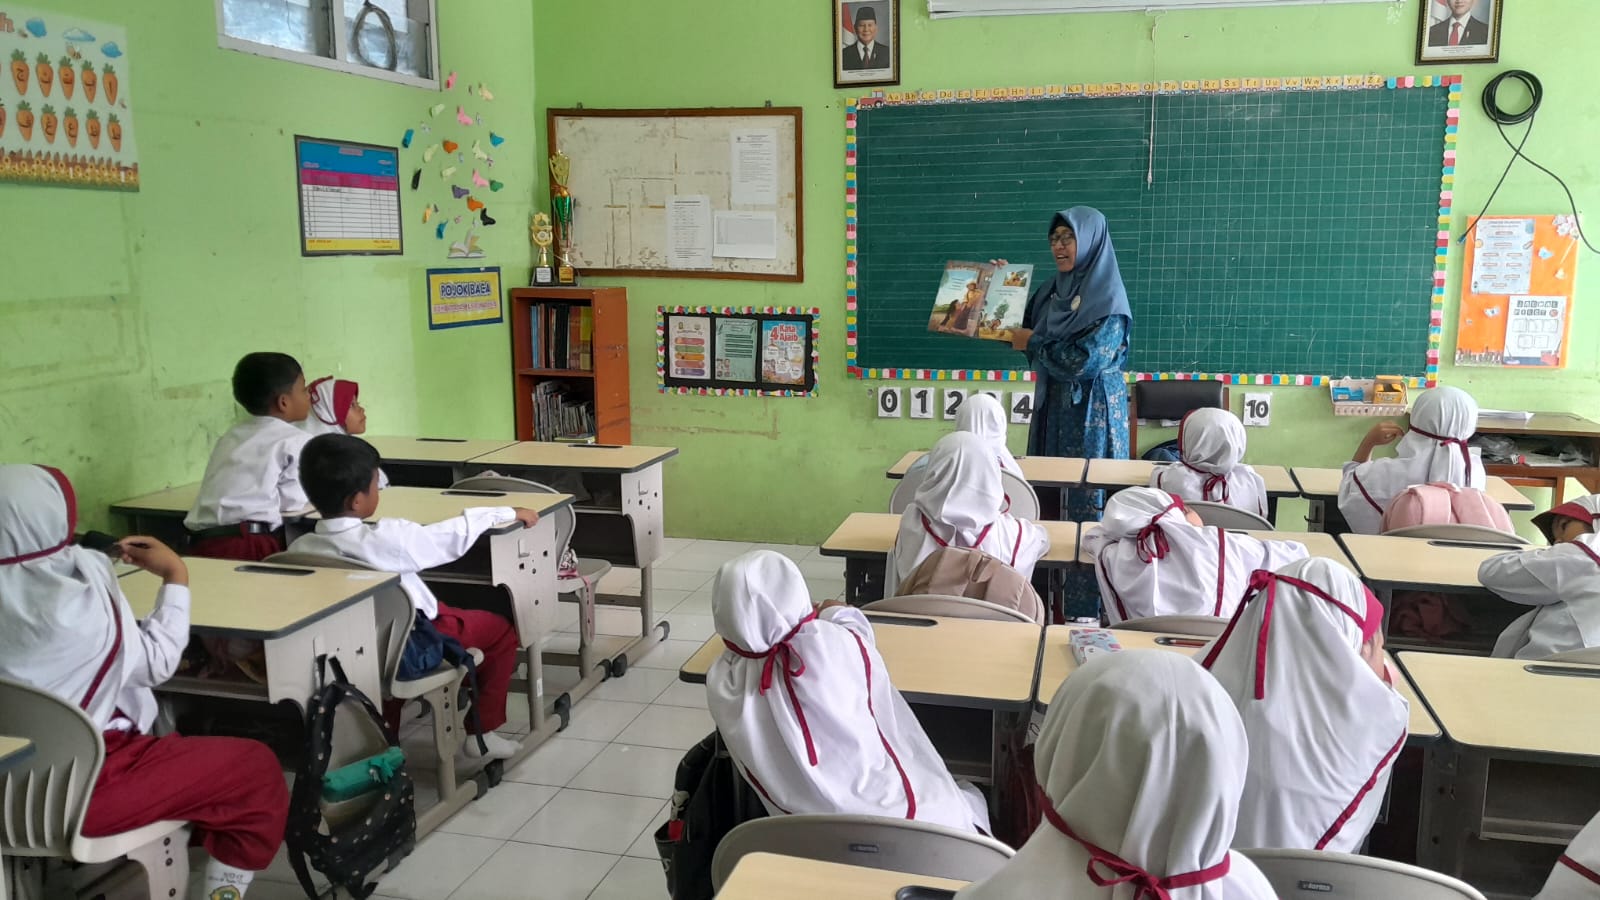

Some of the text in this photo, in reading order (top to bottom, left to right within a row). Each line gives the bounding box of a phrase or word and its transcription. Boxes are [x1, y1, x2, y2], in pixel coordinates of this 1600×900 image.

[440, 283, 469, 298] POJOK
[880, 389, 898, 413] 0
[915, 389, 928, 414] 1
[946, 391, 963, 415] 2
[1012, 394, 1033, 419] 4
[1246, 399, 1269, 419] 10
